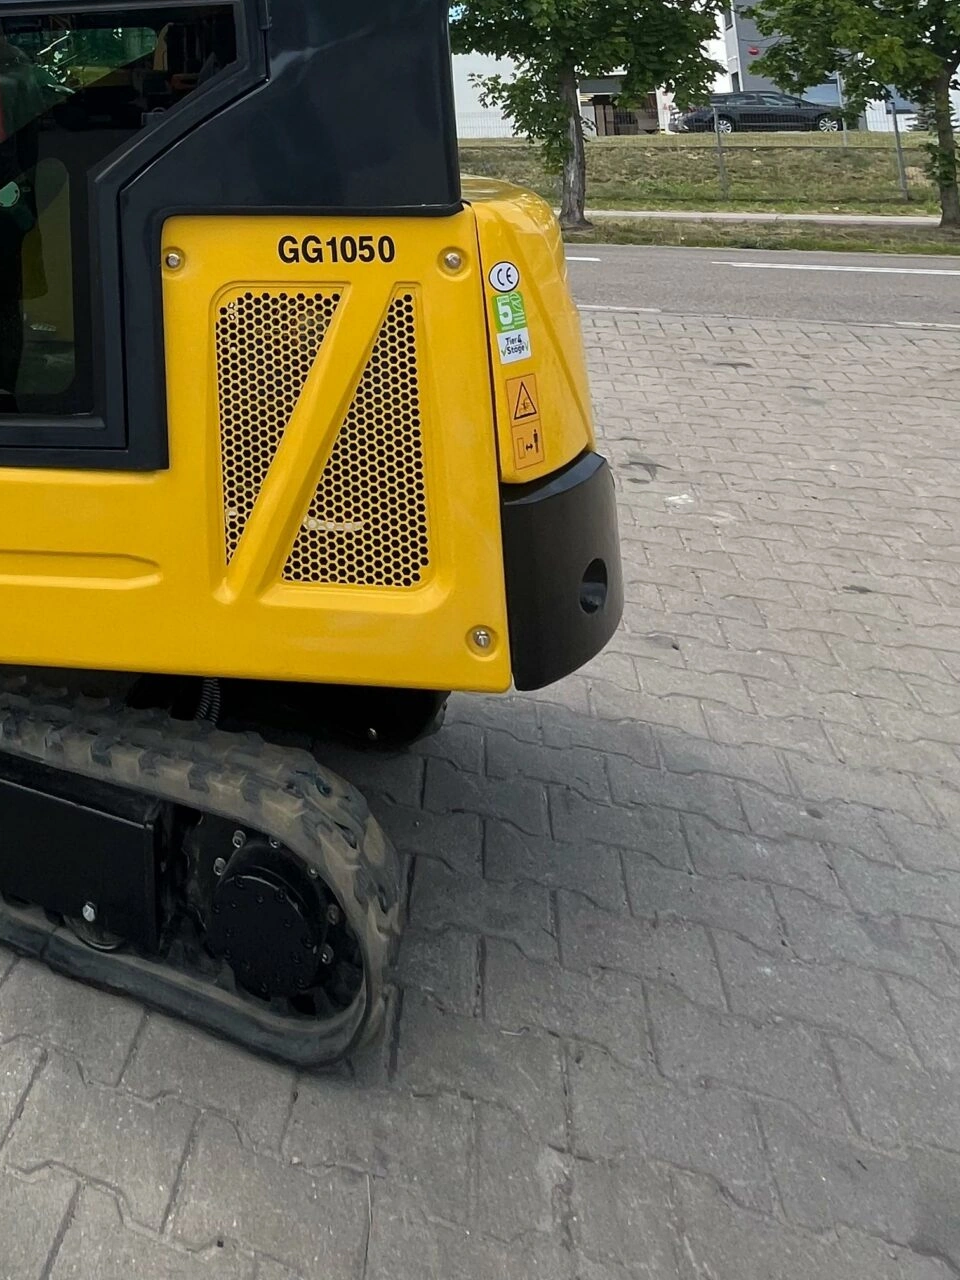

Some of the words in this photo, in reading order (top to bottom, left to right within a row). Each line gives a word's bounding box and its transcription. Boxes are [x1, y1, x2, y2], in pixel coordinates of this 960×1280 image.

[278, 235, 395, 263] GG1050
[497, 267, 513, 286] CE
[497, 297, 513, 325] 5
[505, 336, 518, 346] Tier
[506, 344, 525, 355] Stage
